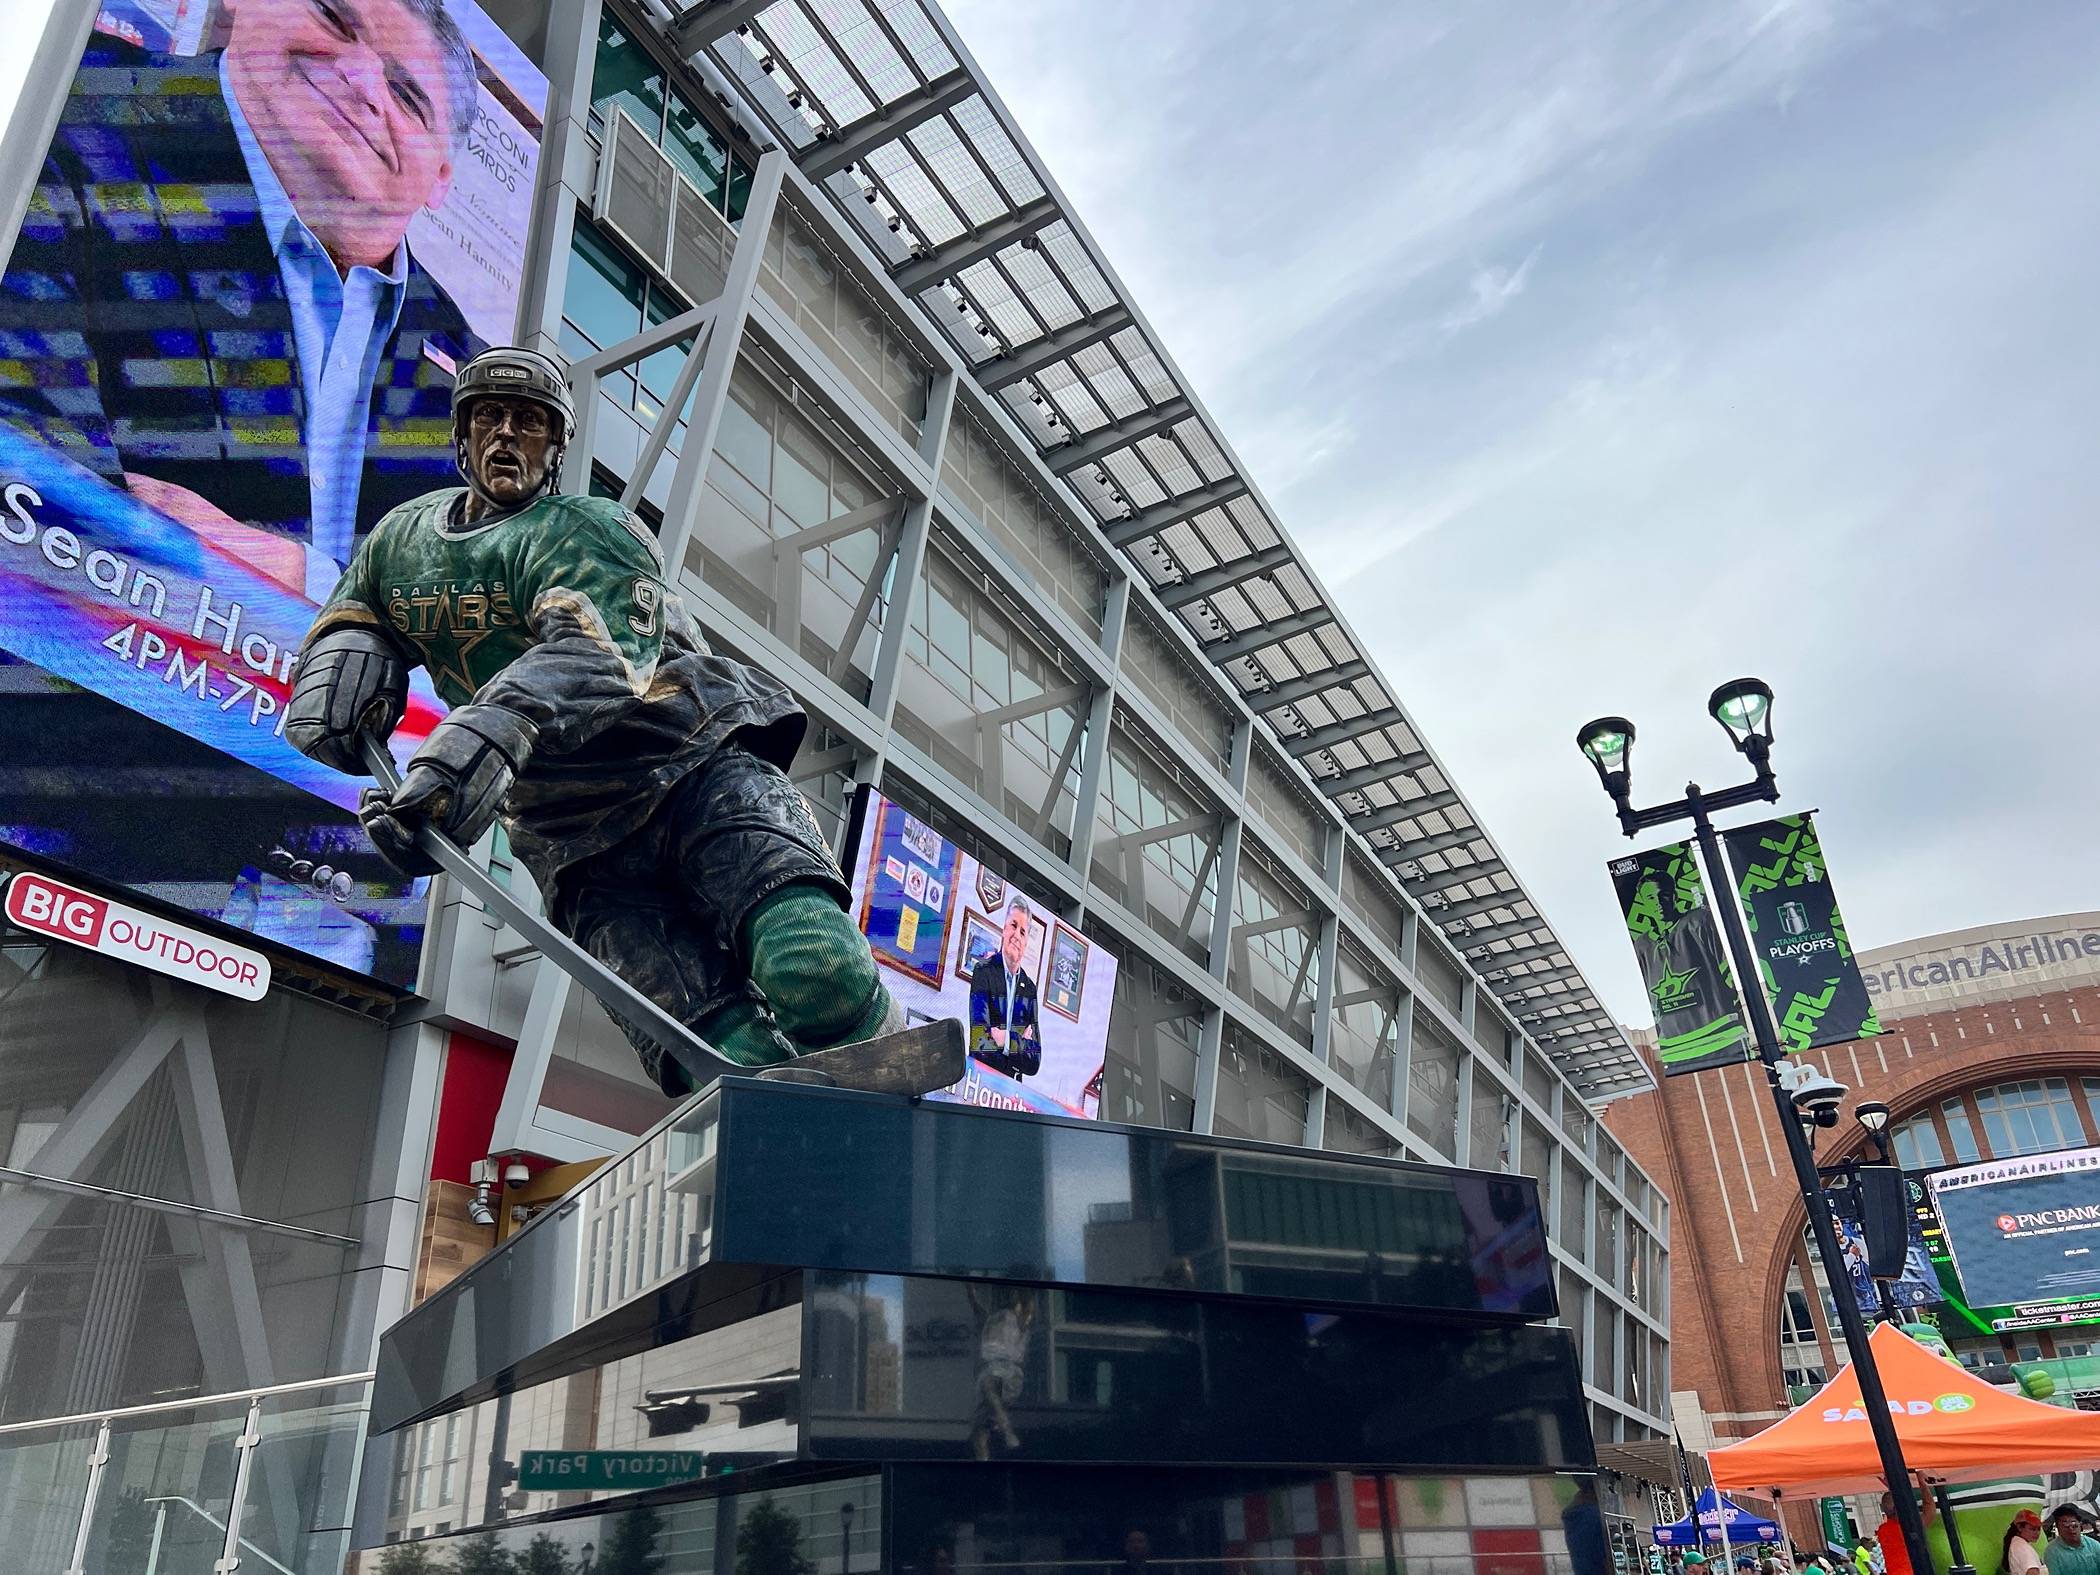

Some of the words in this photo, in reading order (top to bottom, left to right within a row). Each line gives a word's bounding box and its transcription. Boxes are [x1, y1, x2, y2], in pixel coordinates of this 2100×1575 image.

[459, 233, 513, 292] Hannity
[0, 482, 166, 618] Sean
[392, 582, 505, 598] DALLAS
[388, 585, 520, 632] STARS
[629, 577, 663, 637] 9
[1615, 864, 1637, 875] LIGHT
[20, 883, 96, 937] BIG
[109, 919, 259, 988] OUTDOOR
[1770, 938, 1836, 958] PLAYOFFS
[1774, 935, 1808, 946] STANLEY
[1810, 931, 1827, 941] CUP
[964, 1068, 1033, 1112] Hannit
[1852, 1263, 1861, 1277] 21
[1822, 1400, 1933, 1422] SAAD
